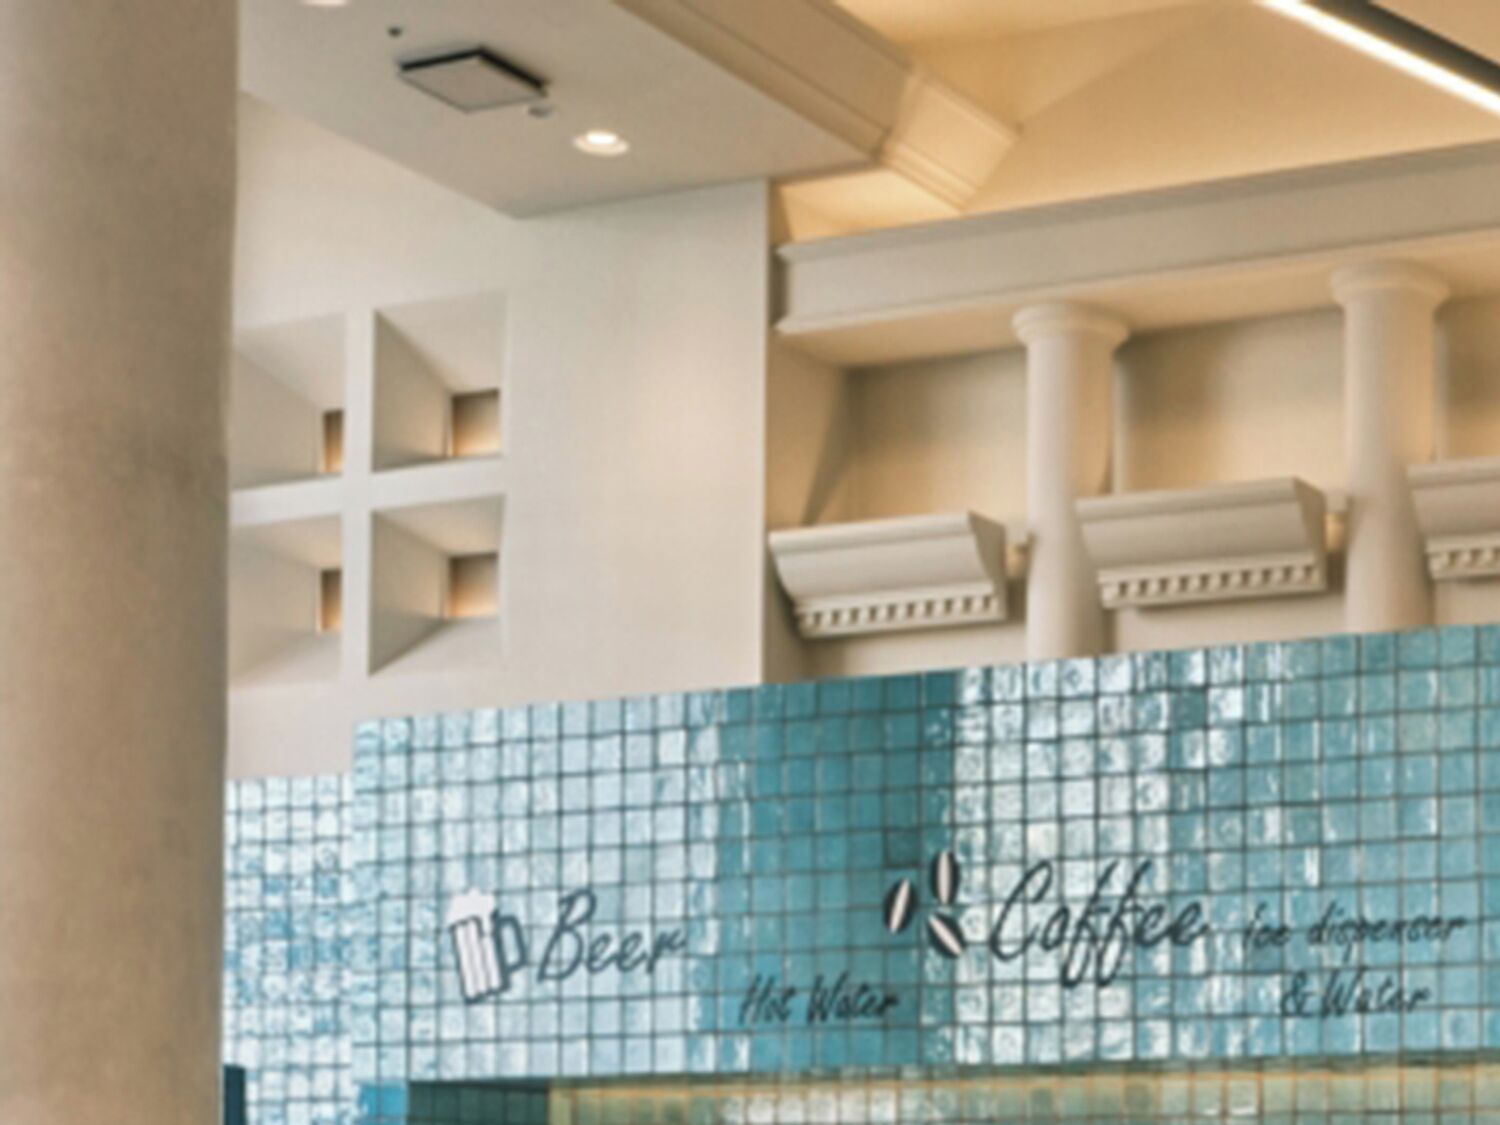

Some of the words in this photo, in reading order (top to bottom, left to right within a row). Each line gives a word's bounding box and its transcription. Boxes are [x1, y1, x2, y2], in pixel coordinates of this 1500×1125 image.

[536, 887, 687, 984] Beer
[988, 858, 1211, 989] Coffee
[1305, 900, 1468, 964] dispenser
[738, 974, 797, 1026] Hot
[806, 970, 900, 1025] Water
[1320, 967, 1431, 1020] Water
